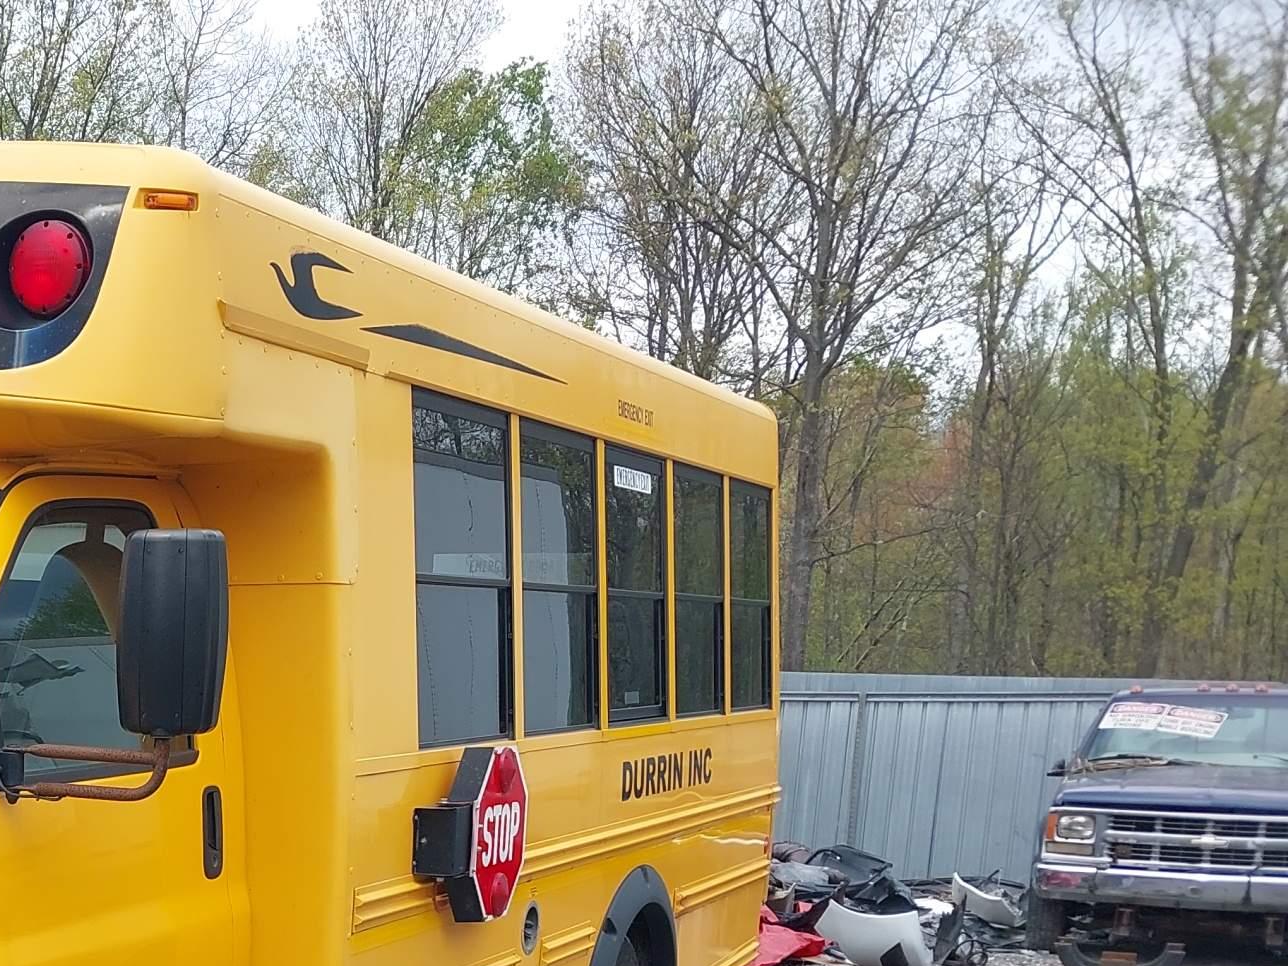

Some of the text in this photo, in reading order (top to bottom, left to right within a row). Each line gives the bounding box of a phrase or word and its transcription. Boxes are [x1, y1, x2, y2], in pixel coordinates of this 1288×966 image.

[618, 399, 655, 428] EMERGENCY EXIT
[621, 747, 713, 802] DURRIN INC
[481, 801, 521, 868] STOP
